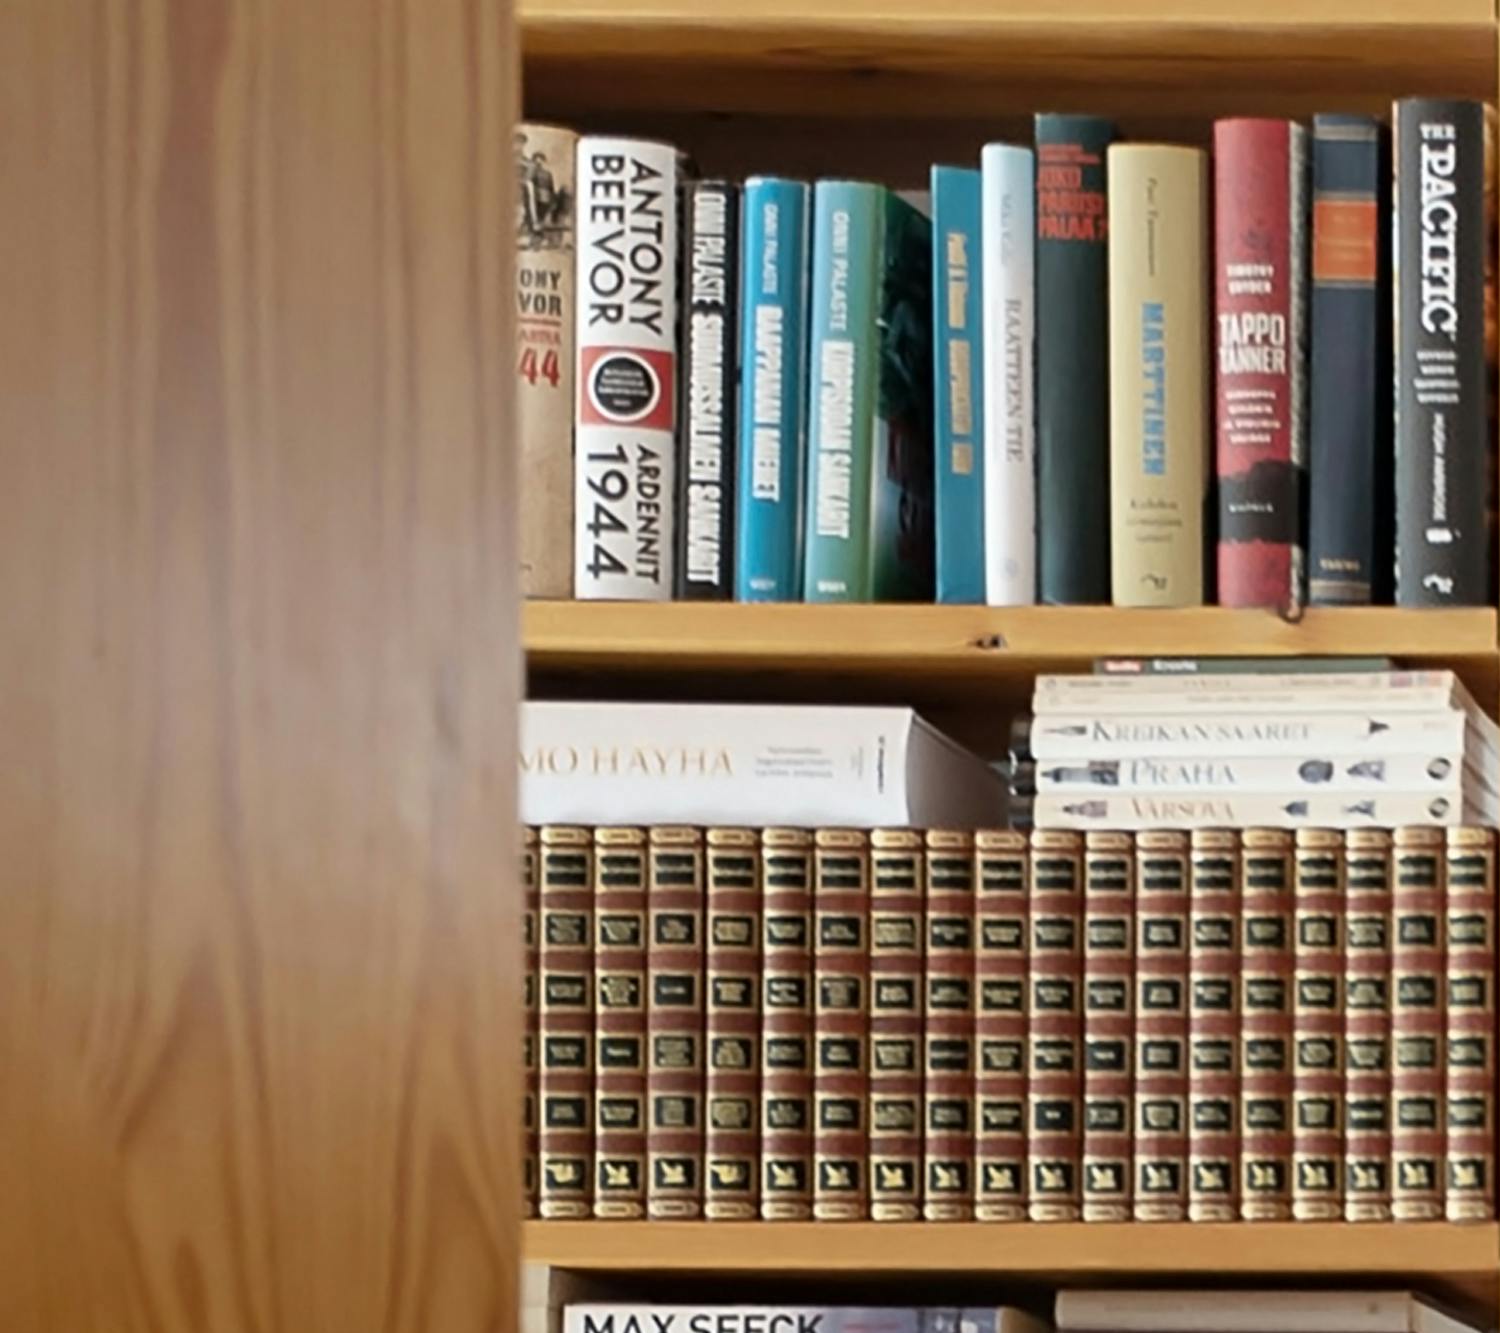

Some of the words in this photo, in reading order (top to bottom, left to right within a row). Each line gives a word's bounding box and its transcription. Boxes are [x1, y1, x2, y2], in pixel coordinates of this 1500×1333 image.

[590, 153, 626, 326] BEEVOR
[630, 158, 664, 337] ANTONY
[829, 257, 850, 332] PALASTE
[1421, 144, 1458, 337] PACIFIC
[1003, 297, 1023, 420] RAATTEEN
[1141, 302, 1166, 477] MARTTINEN
[1217, 313, 1287, 346] TAPPO
[1217, 346, 1288, 376] TANNER
[1003, 424, 1023, 464] TIE
[586, 444, 630, 579] 1944
[635, 444, 661, 585] ARDENNIT
[1130, 760, 1237, 786] PRAHA
